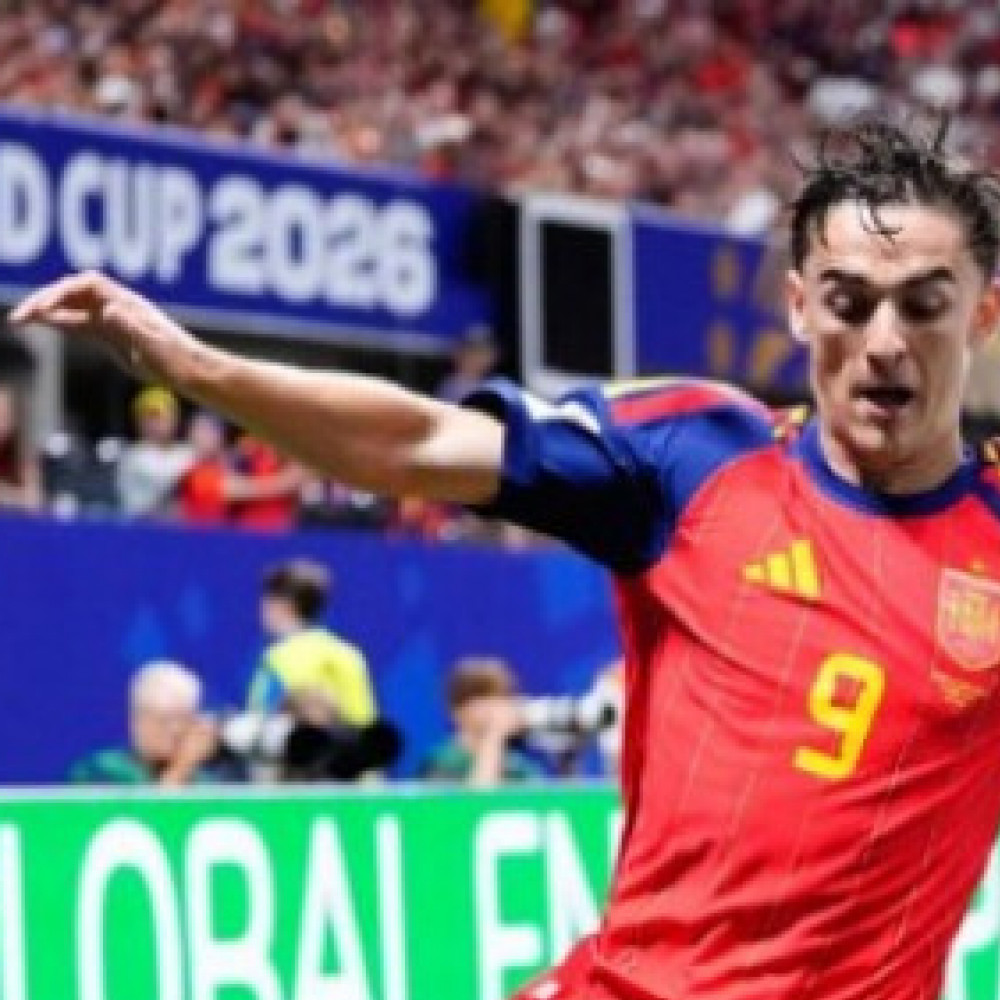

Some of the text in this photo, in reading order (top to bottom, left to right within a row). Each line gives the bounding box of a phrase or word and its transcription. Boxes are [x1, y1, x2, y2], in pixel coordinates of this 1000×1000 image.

[60, 152, 202, 284] CUP
[206, 174, 439, 317] 2026
[795, 653, 885, 780] 9
